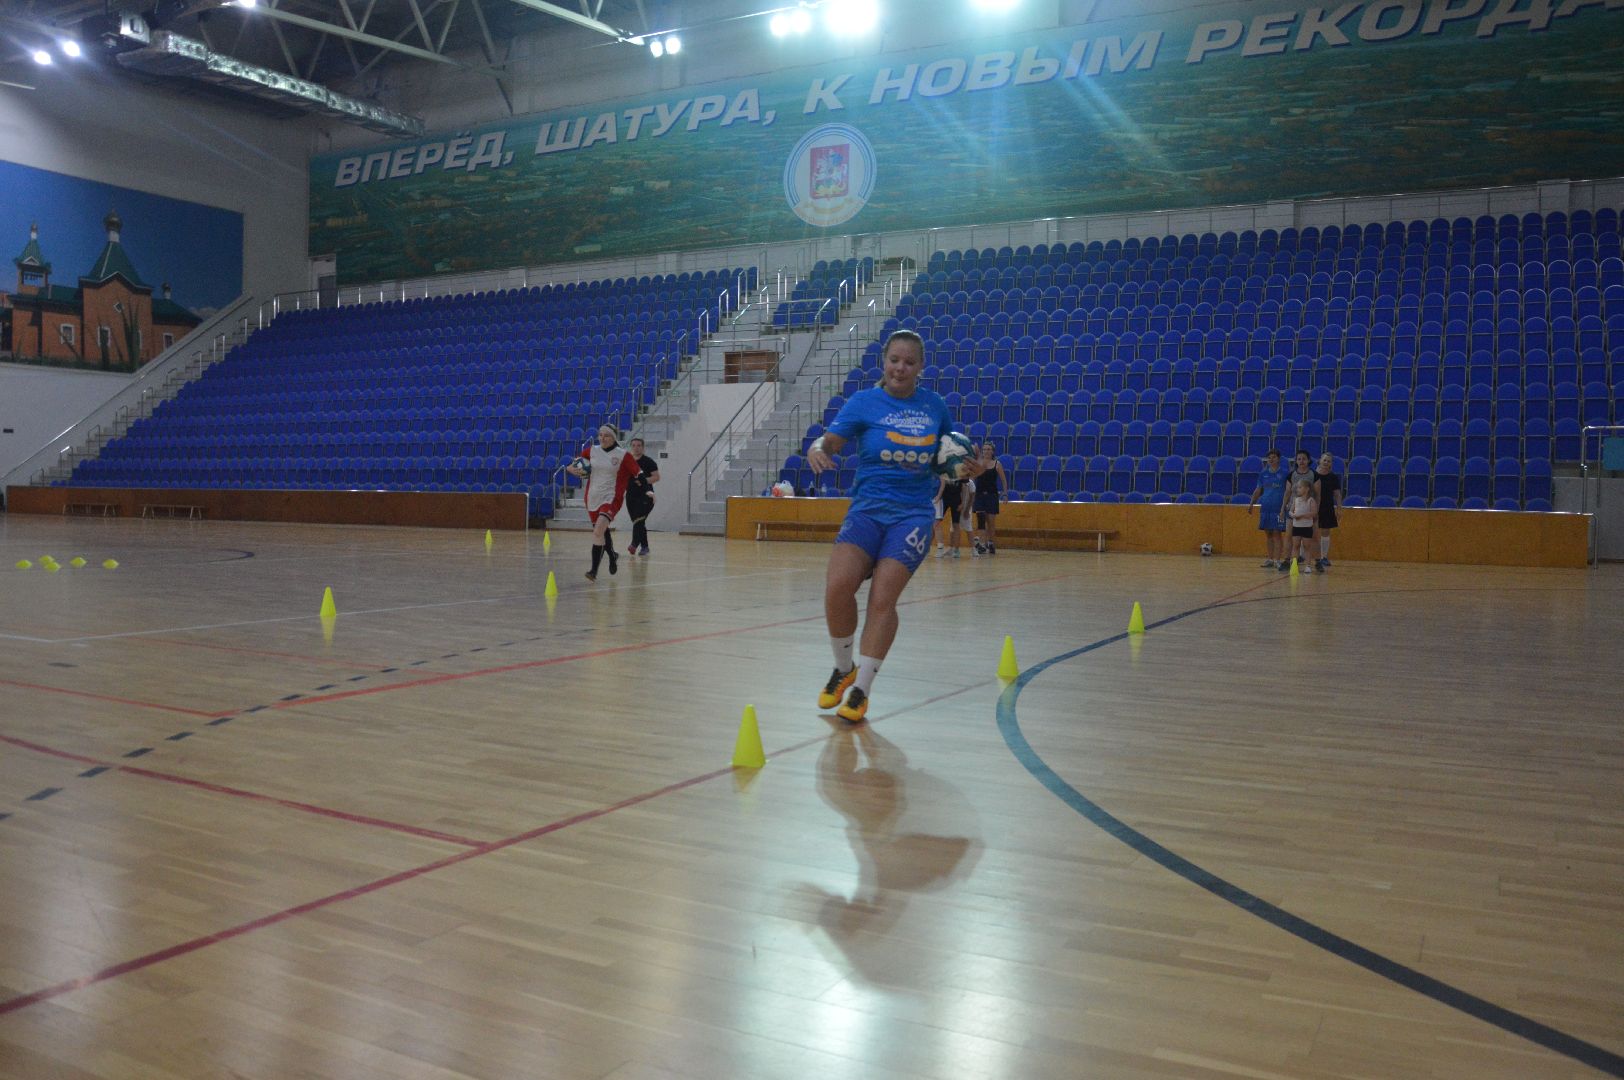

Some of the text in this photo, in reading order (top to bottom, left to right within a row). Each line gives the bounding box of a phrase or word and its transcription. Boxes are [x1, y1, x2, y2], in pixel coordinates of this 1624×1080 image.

[334, 129, 515, 188] ВПЕРЁД,
[534, 88, 776, 156] ШАТУРА,
[804, 74, 855, 114] К
[869, 30, 1162, 104] НОВЫМ
